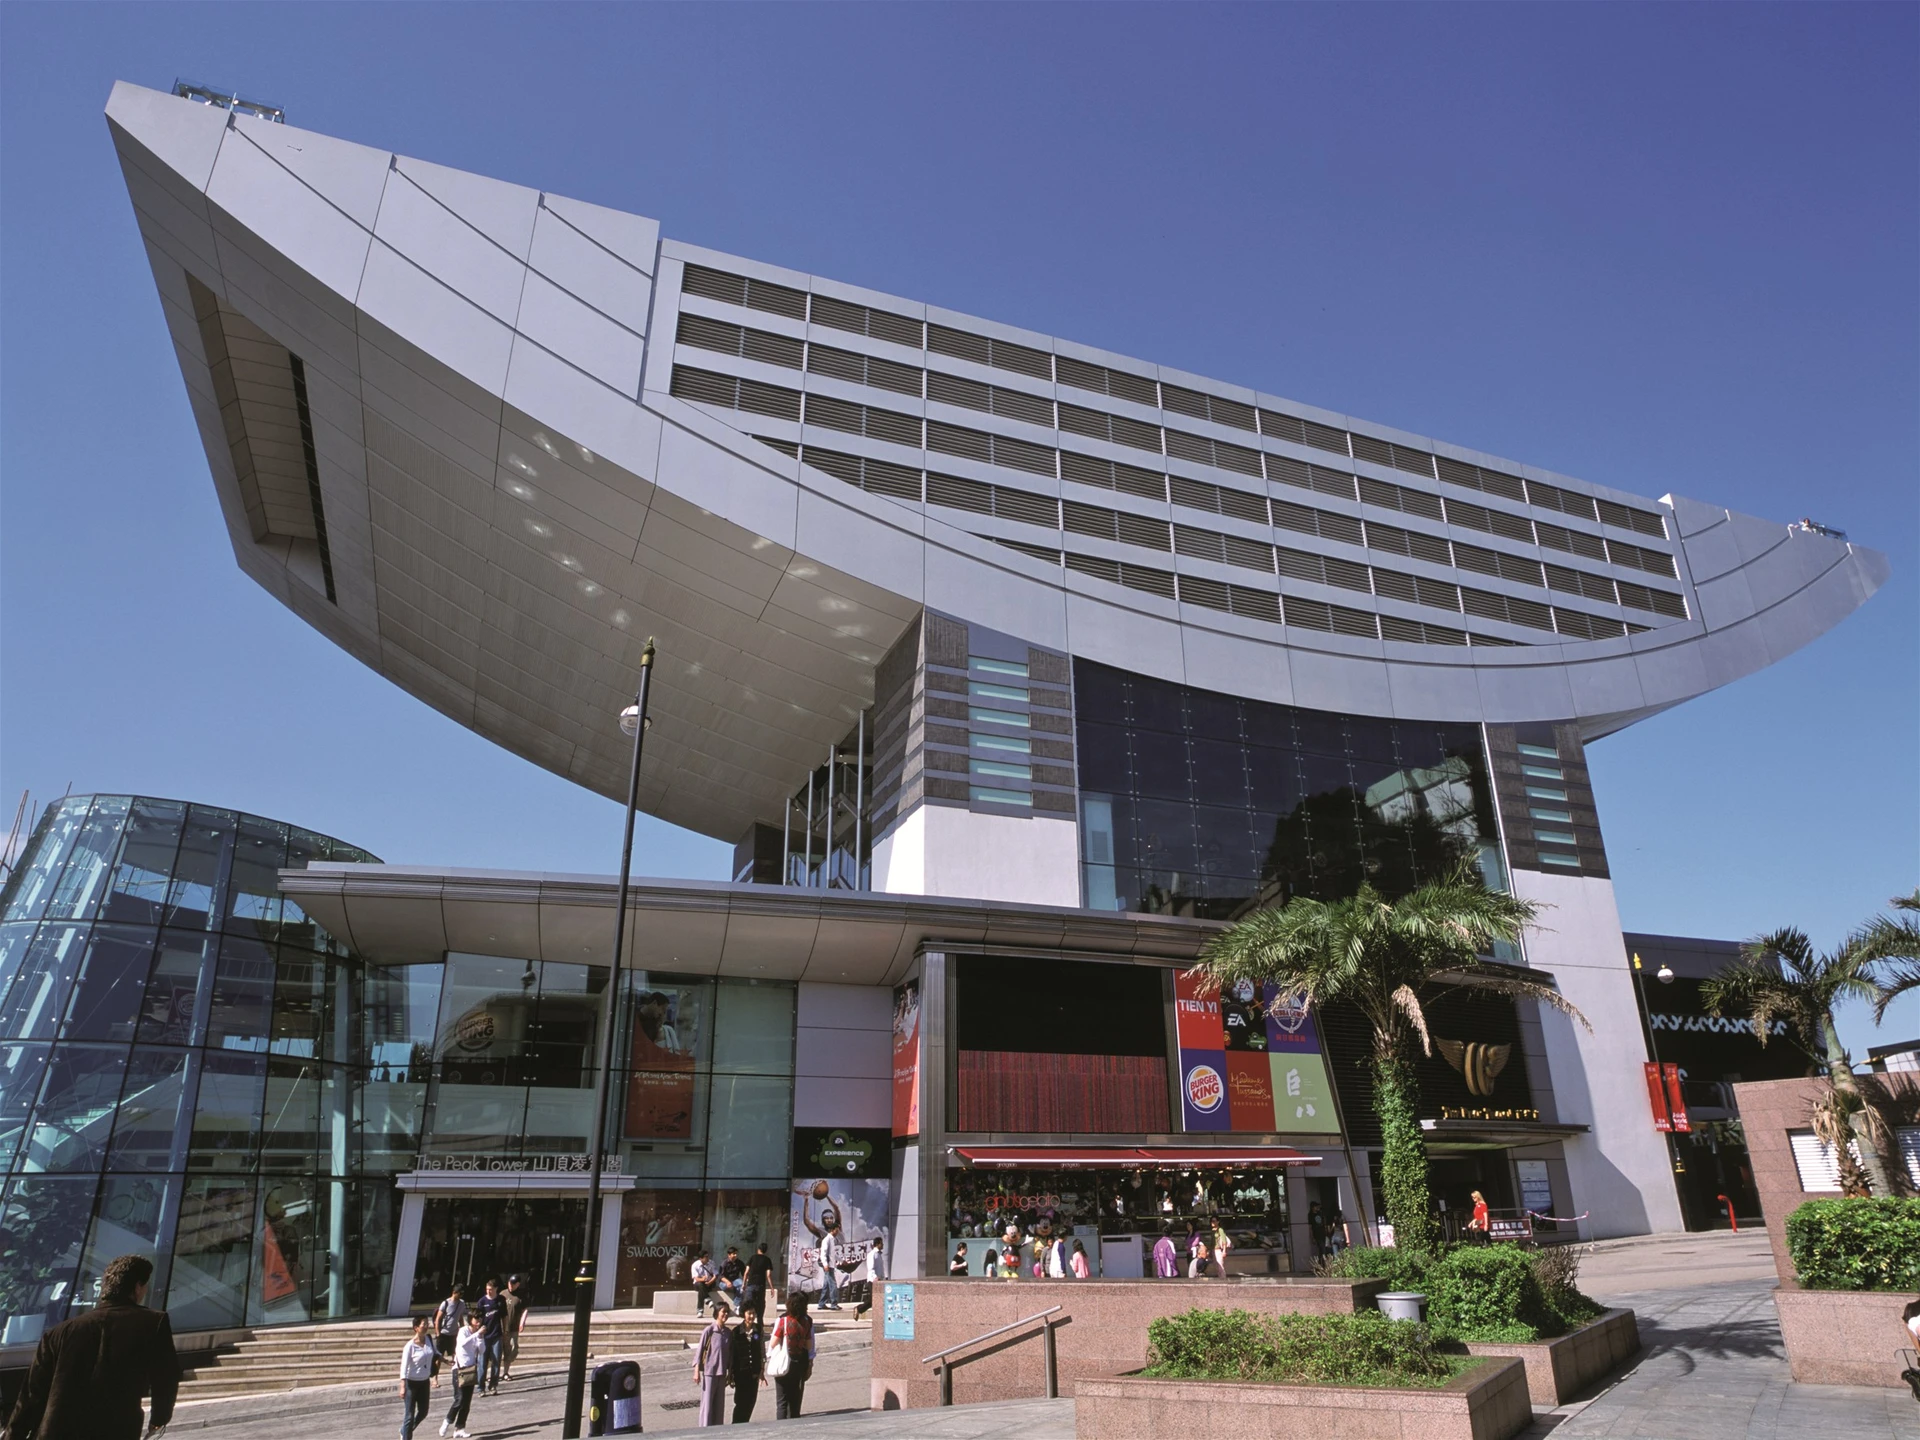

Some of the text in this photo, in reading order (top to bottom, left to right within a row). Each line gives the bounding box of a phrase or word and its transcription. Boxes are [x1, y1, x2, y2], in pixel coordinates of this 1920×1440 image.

[1179, 999, 1218, 1014] TIEN YI
[1227, 1013, 1247, 1027] EA
[1190, 1074, 1218, 1091] BURGER
[1192, 1083, 1220, 1102] KING
[415, 1155, 442, 1171] The
[445, 1155, 480, 1171] Peak
[483, 1155, 529, 1172] Tower
[626, 1245, 689, 1258] SWAROVSKI
[811, 1239, 875, 1262] SREET
